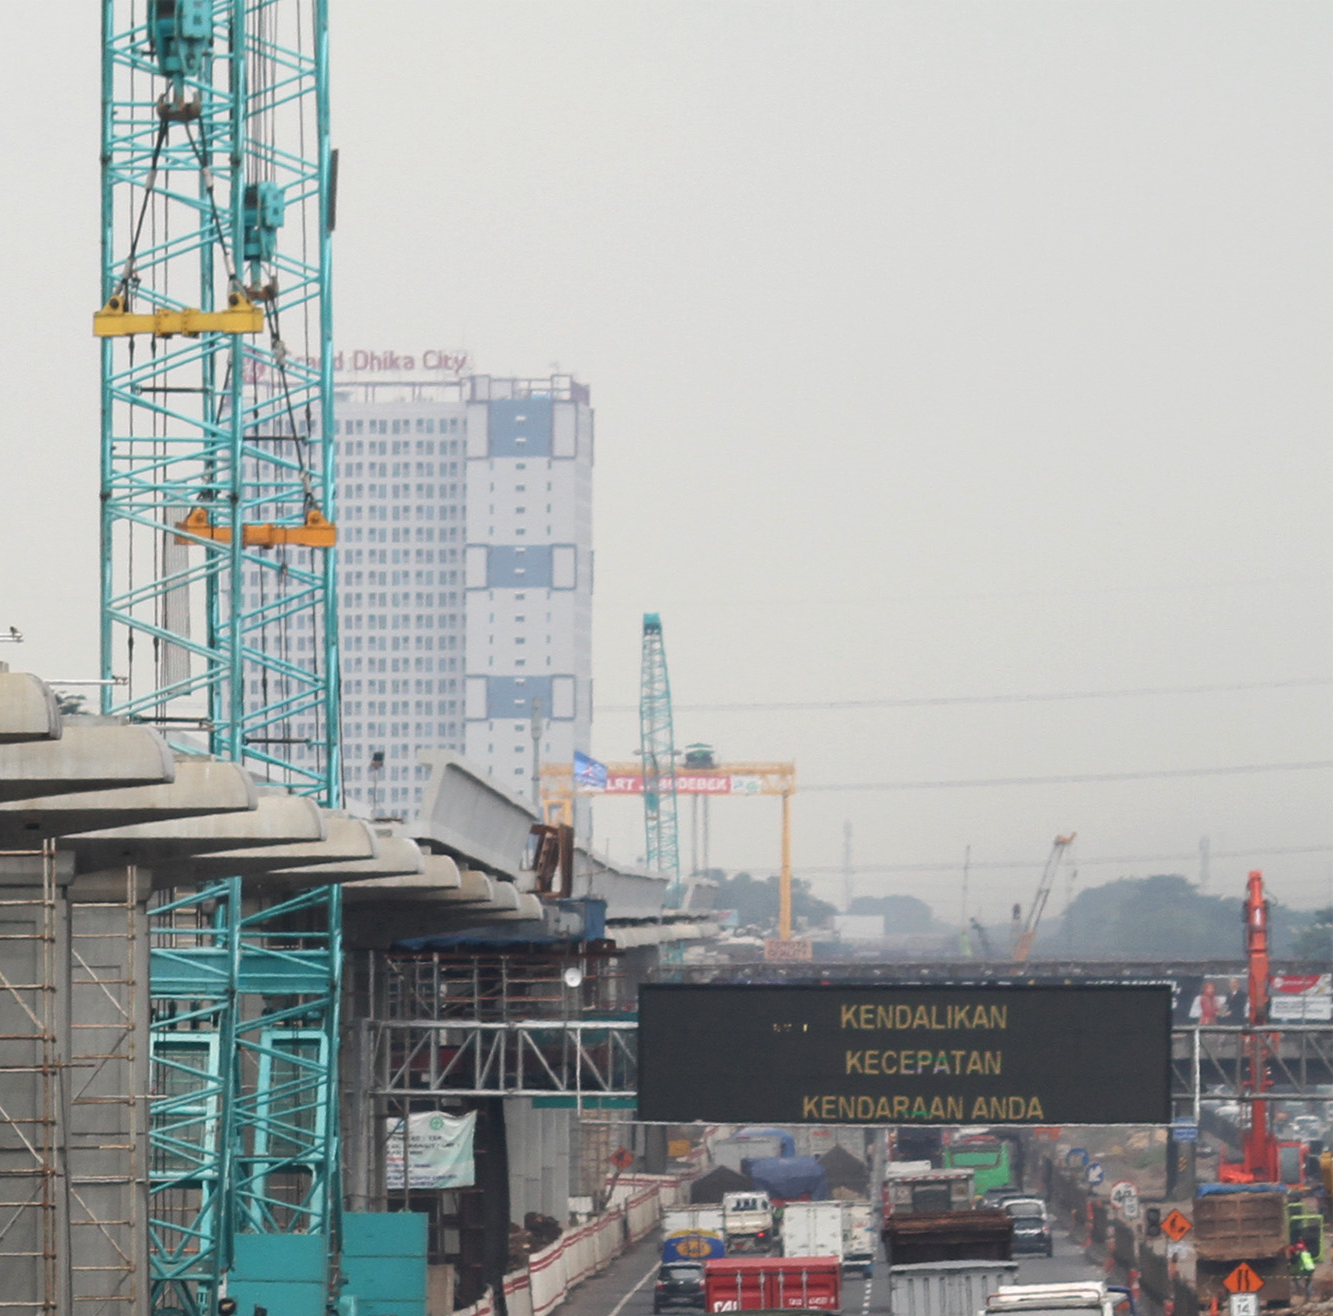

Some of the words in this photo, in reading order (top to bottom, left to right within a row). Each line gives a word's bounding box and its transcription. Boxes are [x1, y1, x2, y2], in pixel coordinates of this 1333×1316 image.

[353, 349, 415, 371] Dhika
[423, 349, 468, 374] City
[839, 1003, 1008, 1031] KENDALIKAN
[845, 1048, 1003, 1076] KECEPATAN
[801, 1095, 964, 1121] KENDARAAN
[970, 1095, 1045, 1121] ANDA
